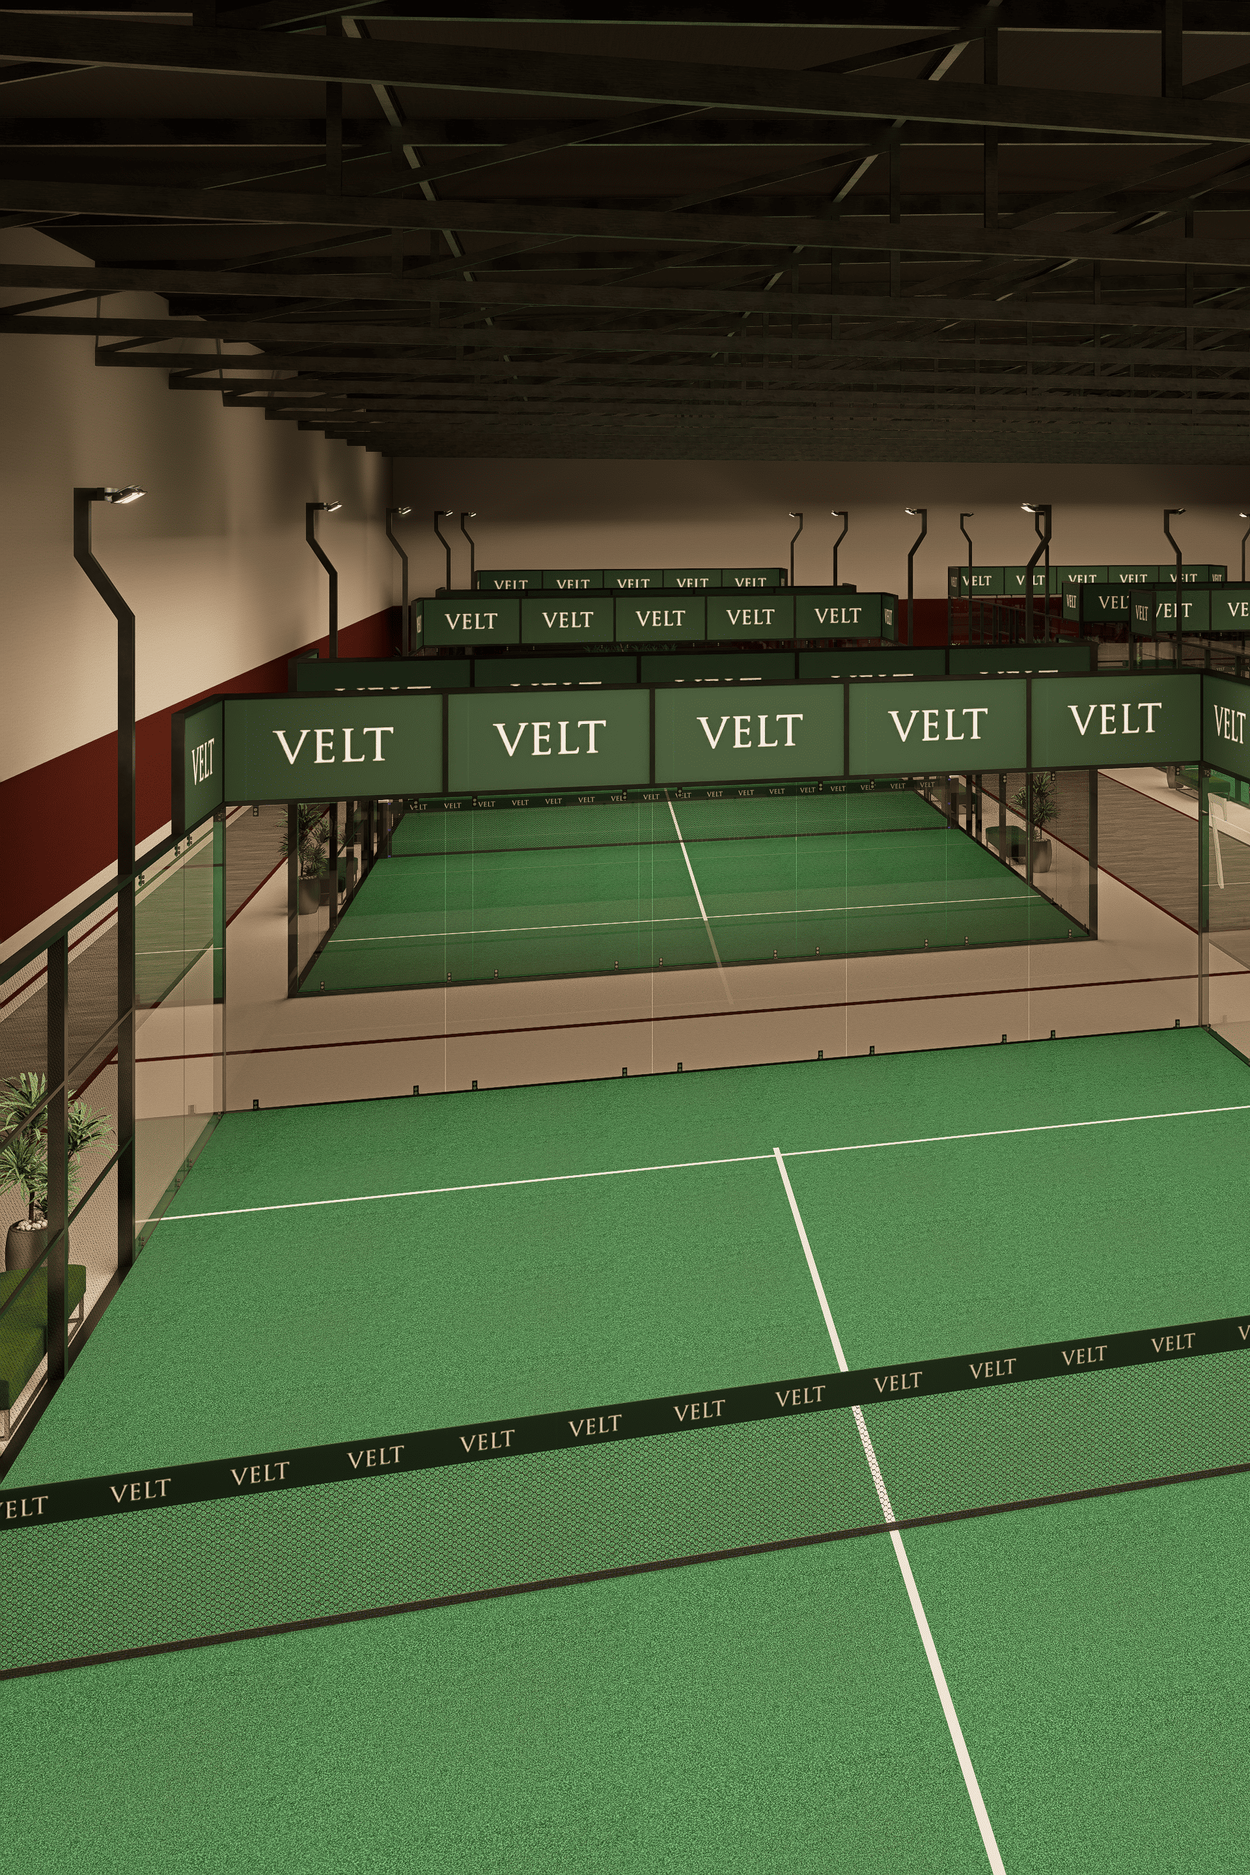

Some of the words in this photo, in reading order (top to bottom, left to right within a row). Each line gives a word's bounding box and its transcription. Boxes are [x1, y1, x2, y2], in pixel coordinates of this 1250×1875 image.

[1016, 575, 1046, 586] VLT
[1098, 595, 1130, 609] VEL
[1135, 604, 1149, 621] VELT
[445, 613, 497, 629] VELT
[542, 612, 593, 628] VELT
[636, 611, 685, 626] VELT
[726, 609, 775, 625] VELT
[815, 608, 861, 623] VELT
[273, 727, 393, 764] VELT
[493, 720, 606, 756] VELT
[697, 714, 803, 749] VELT
[888, 708, 988, 742] VELT
[1068, 703, 1161, 735] VELT
[1214, 705, 1246, 744] VELT
[192, 738, 214, 785] VELT
[478, 800, 496, 808] VELT
[545, 797, 563, 805] VELT
[0, 1495, 48, 1519] ELT
[111, 1479, 171, 1502] VELT
[231, 1462, 289, 1485] VELT
[348, 1446, 404, 1468] VELT
[461, 1430, 515, 1452] VELT
[569, 1415, 621, 1436] VELT
[674, 1400, 725, 1421] VELT
[776, 1386, 825, 1406] VELT
[875, 1372, 922, 1392] VELT
[970, 1358, 1016, 1378] VELT
[1062, 1346, 1107, 1365] VELT
[1152, 1333, 1195, 1352] VELT
